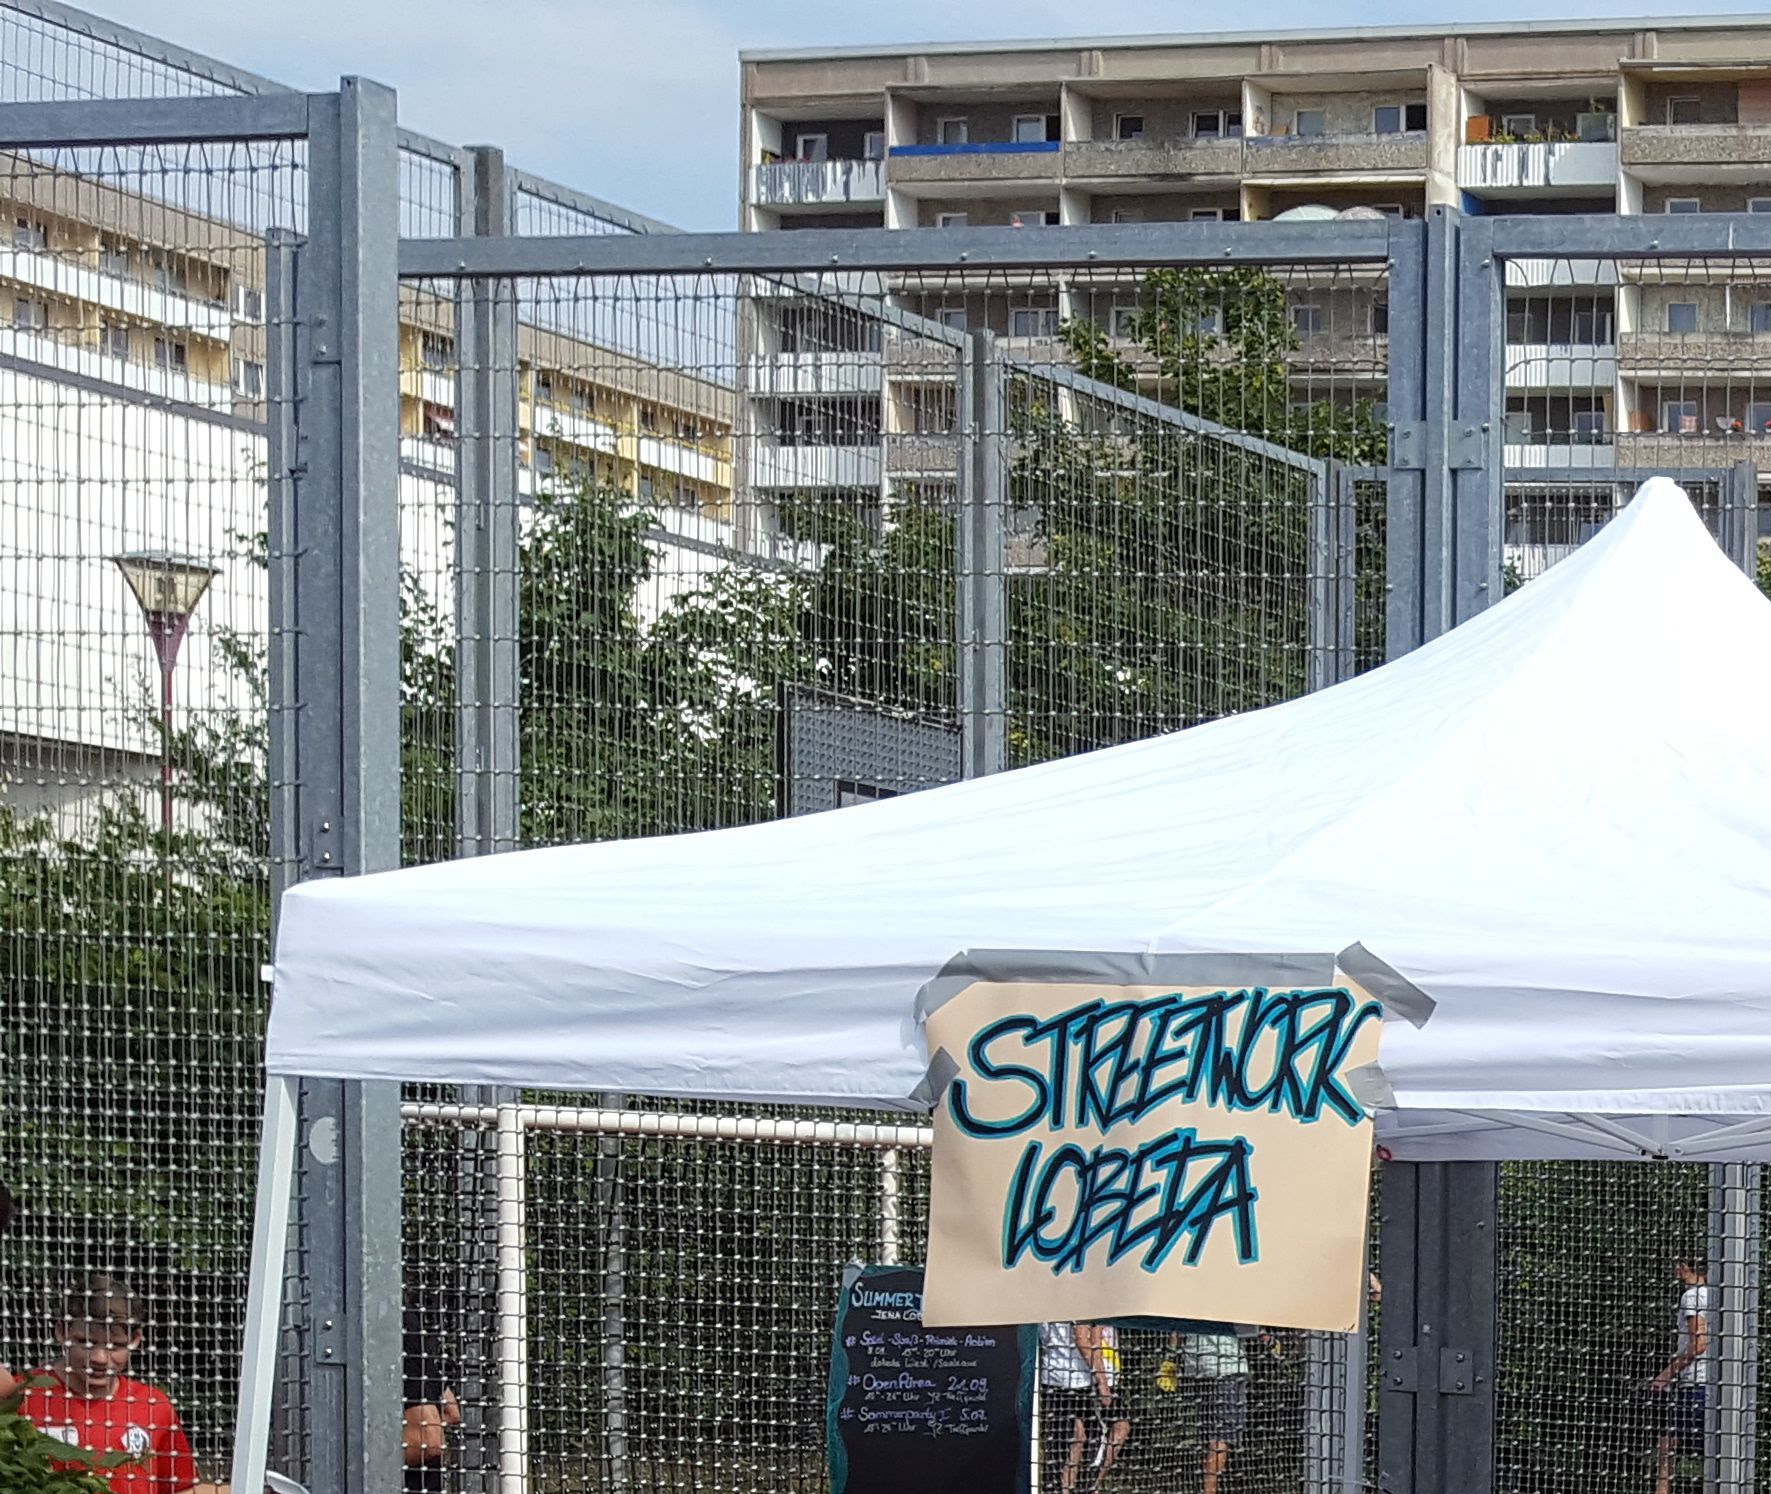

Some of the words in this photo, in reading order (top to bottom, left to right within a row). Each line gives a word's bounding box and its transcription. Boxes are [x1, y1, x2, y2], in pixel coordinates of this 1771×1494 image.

[948, 987, 1384, 1139] STREETWORK
[1002, 1127, 1259, 1277] LOBEDA
[851, 1282, 914, 1307] SUMMER
